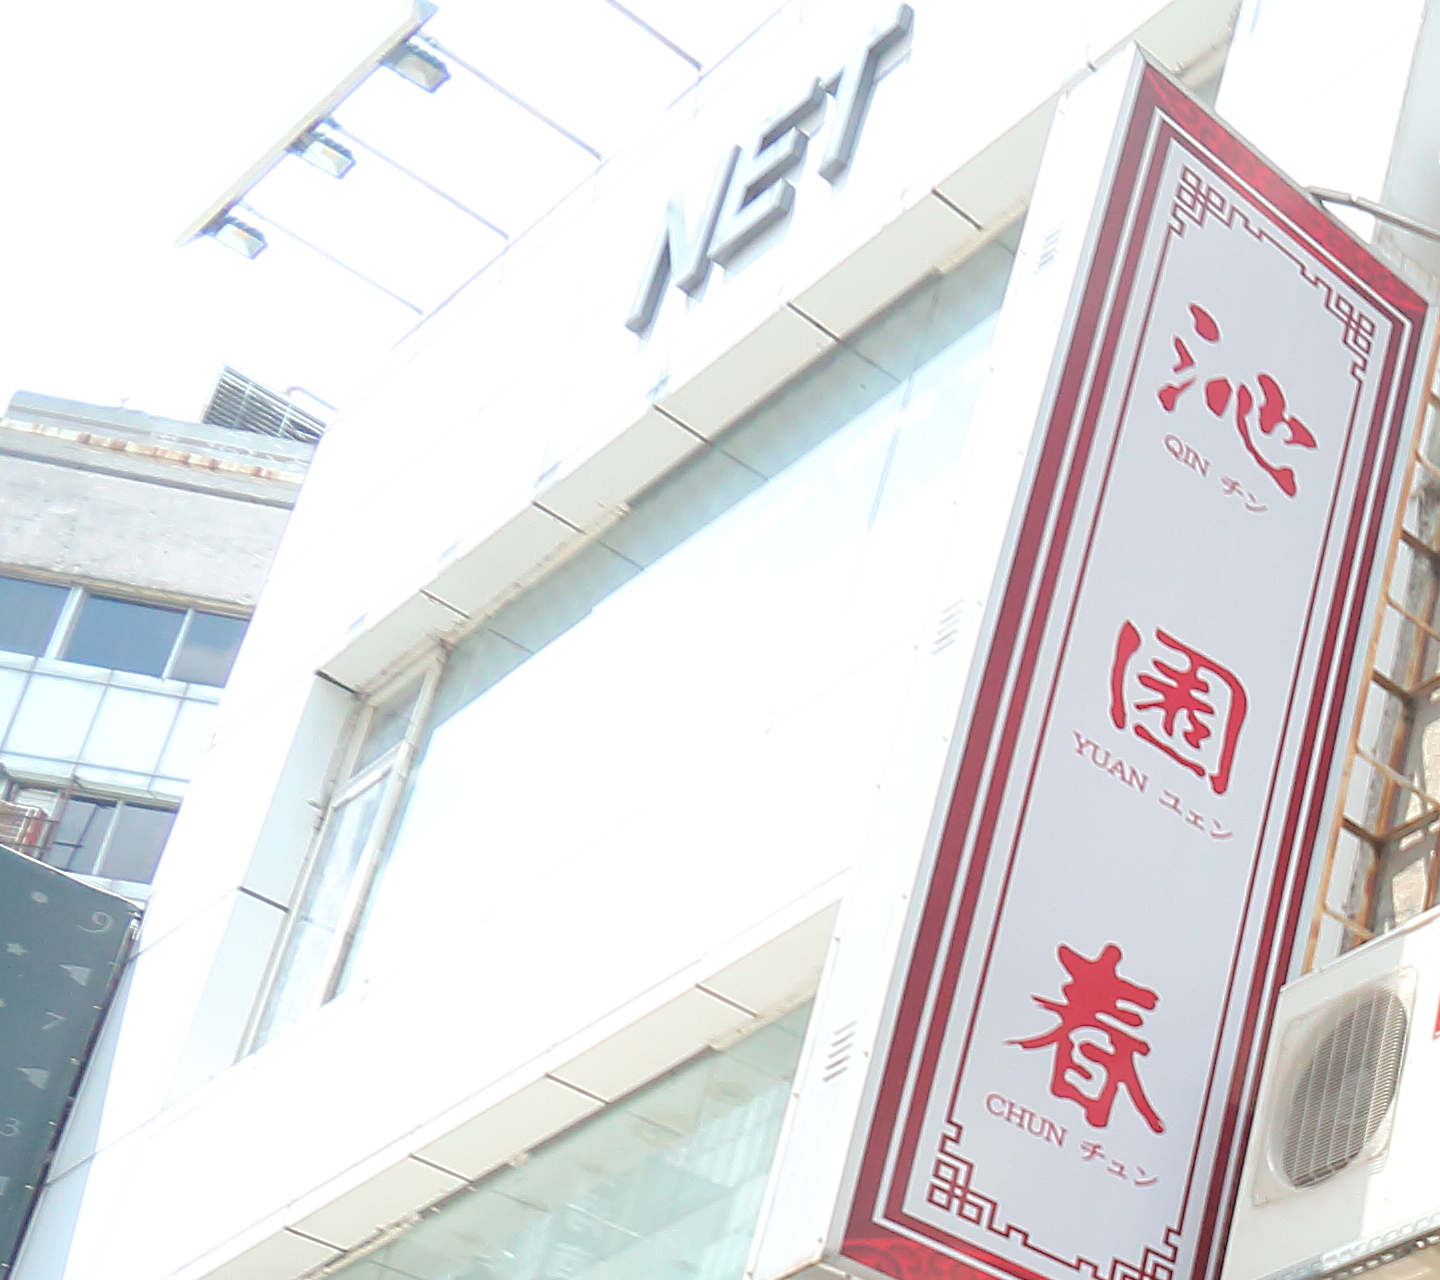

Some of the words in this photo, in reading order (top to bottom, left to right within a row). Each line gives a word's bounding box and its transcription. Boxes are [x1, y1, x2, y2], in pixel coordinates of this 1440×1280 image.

[625, 2, 914, 334] NET
[1157, 303, 1317, 497] 沁
[1164, 434, 1211, 478] QIN
[1220, 475, 1269, 512] チン
[1073, 729, 1149, 792] YUAN
[1002, 943, 1165, 1134] 春
[986, 1093, 1068, 1147] CHUN
